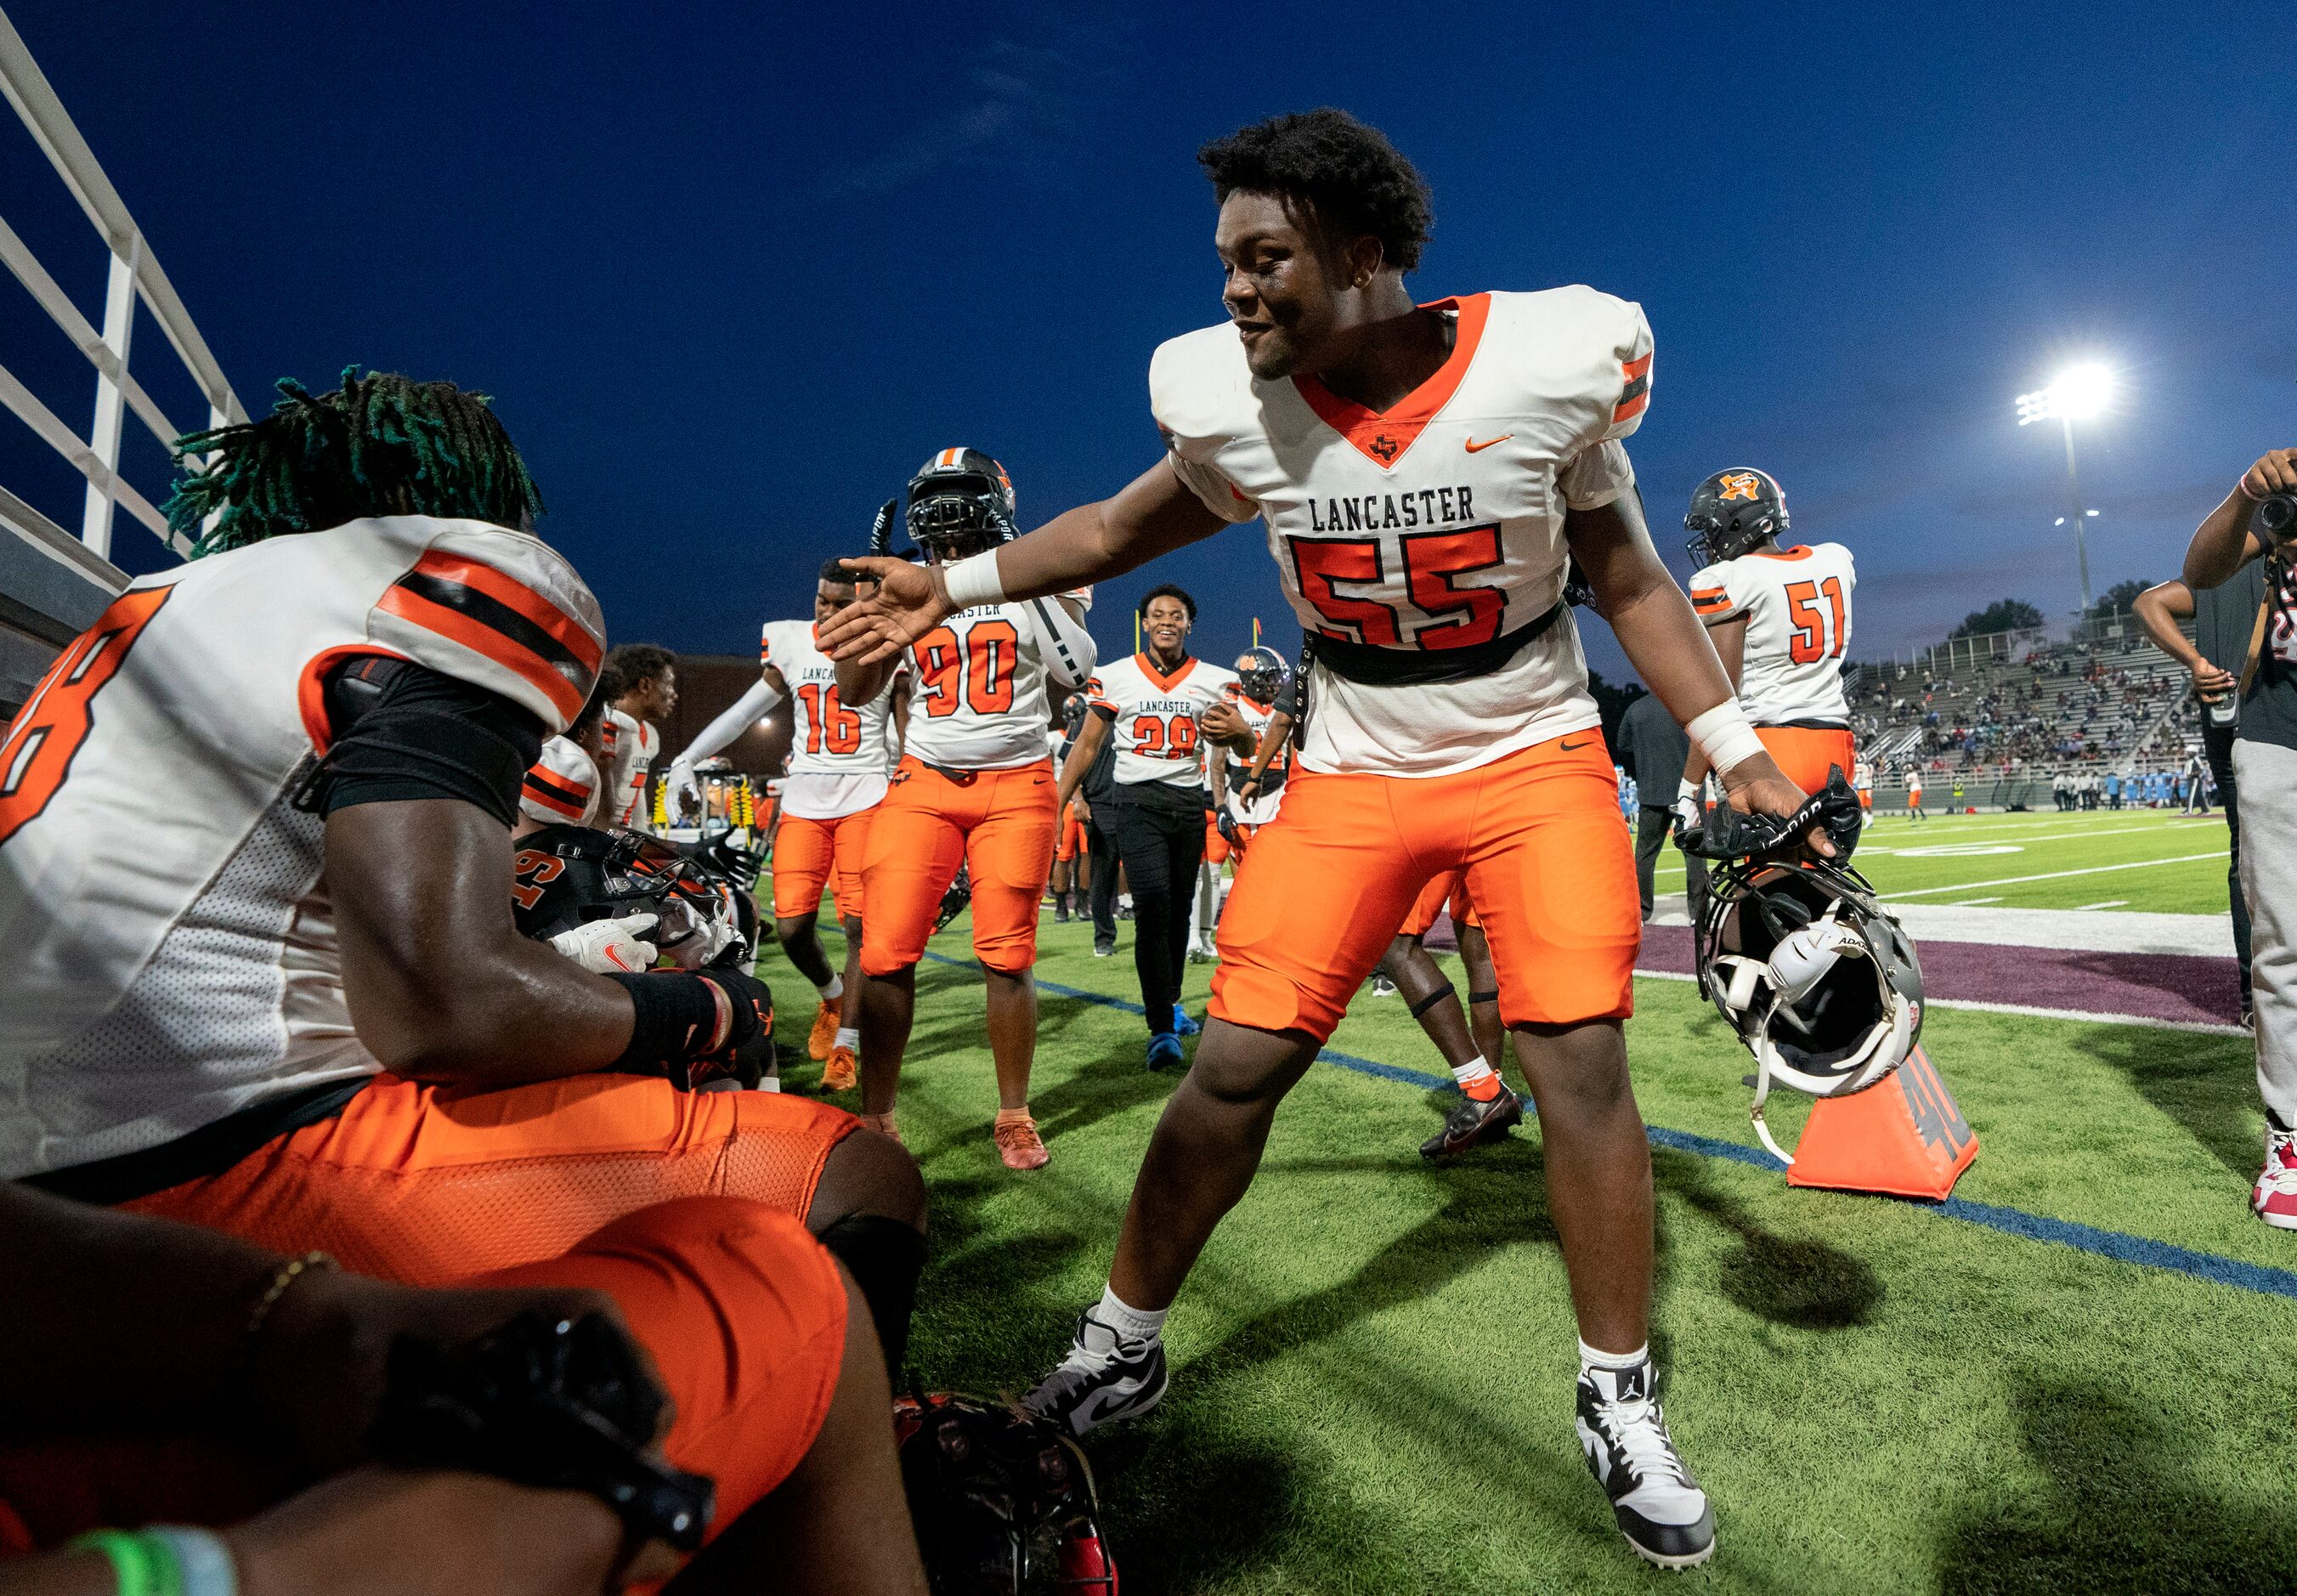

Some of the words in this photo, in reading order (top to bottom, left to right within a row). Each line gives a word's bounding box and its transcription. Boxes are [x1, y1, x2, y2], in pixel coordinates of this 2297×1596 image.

[870, 512, 887, 550] VAPOR
[1309, 486, 1475, 531] LANCASTER
[1286, 522, 1509, 651] 55
[1784, 576, 1846, 665] 51
[802, 668, 834, 680] LANCA
[912, 619, 1018, 718] 90
[797, 683, 861, 754] 16
[1140, 701, 1191, 713] LANCASTER
